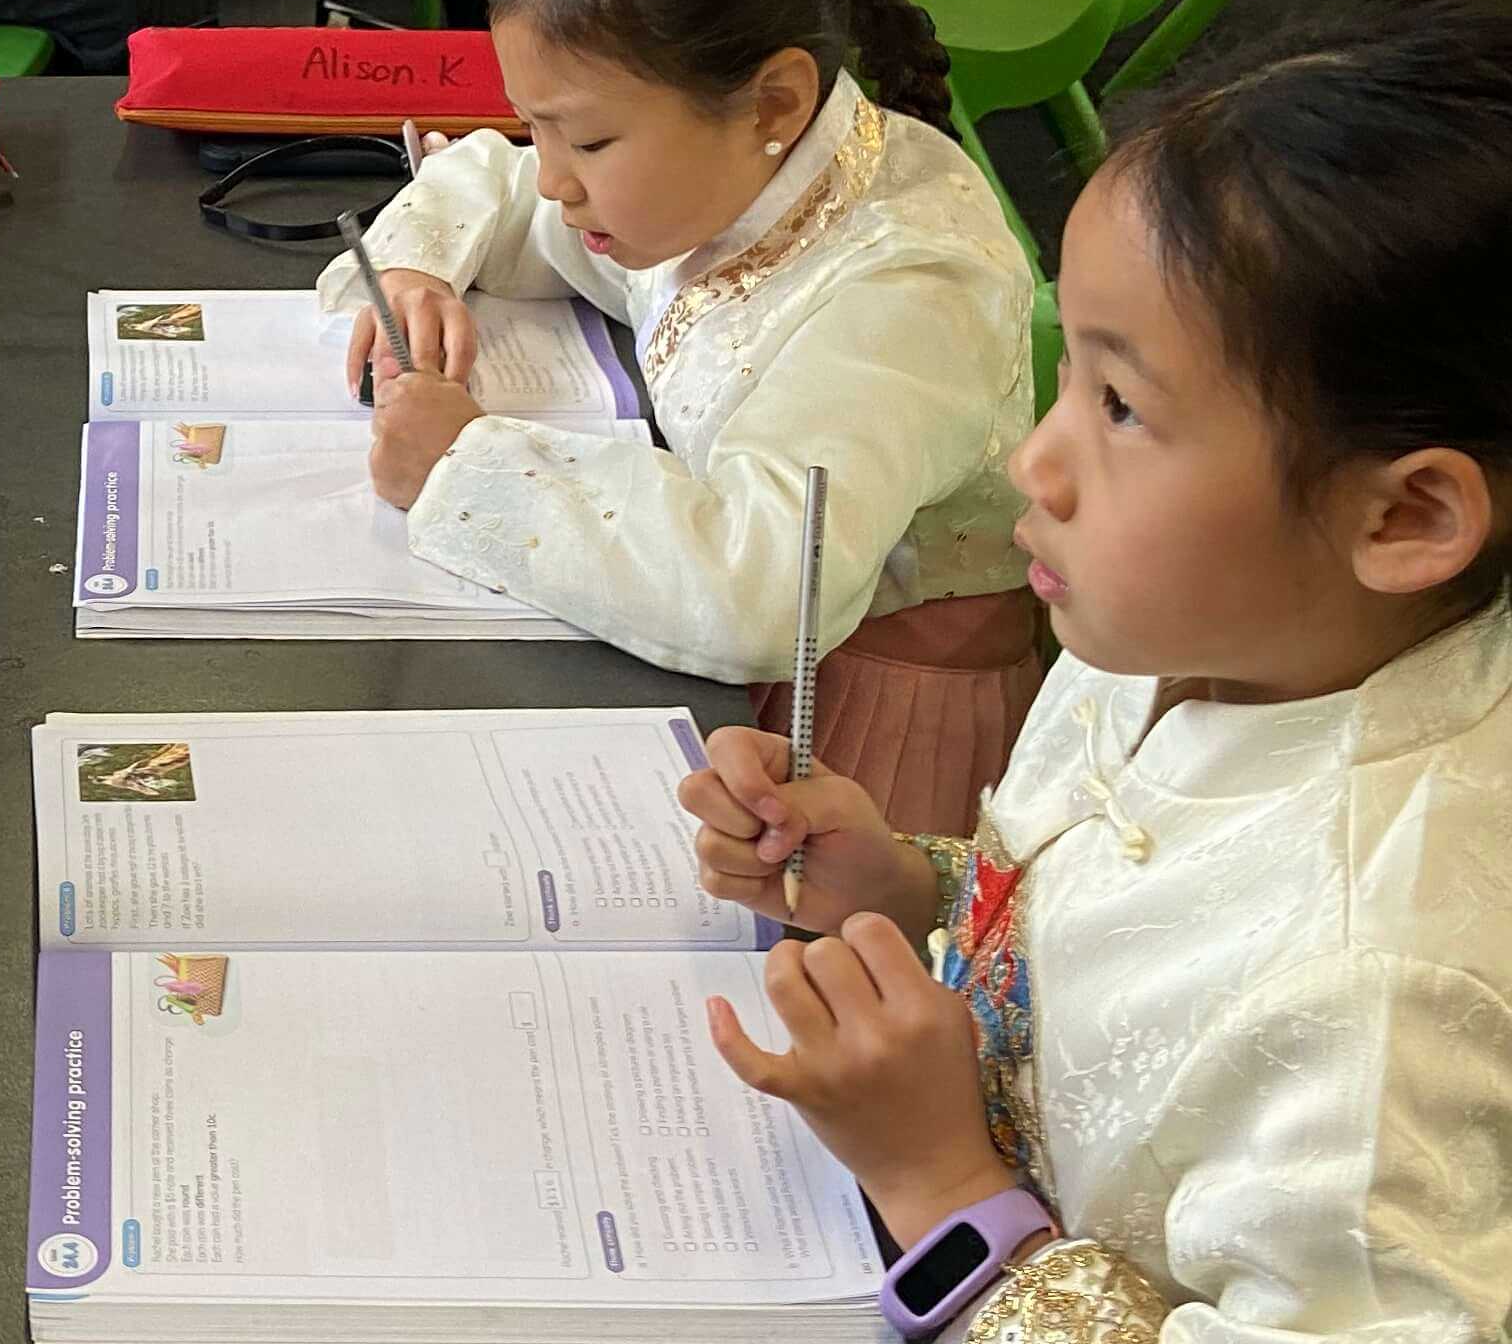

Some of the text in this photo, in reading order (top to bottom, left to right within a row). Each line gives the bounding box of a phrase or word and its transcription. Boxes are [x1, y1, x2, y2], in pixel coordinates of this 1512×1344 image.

[440, 56, 471, 87] K
[102, 472, 120, 571] Problem-solving practice
[61, 1030, 87, 1225] Problem-solving practice
[207, 1130, 217, 1149] than
[208, 1151, 219, 1181] greater
[180, 1184, 190, 1208] round
[195, 1175, 205, 1209] different
